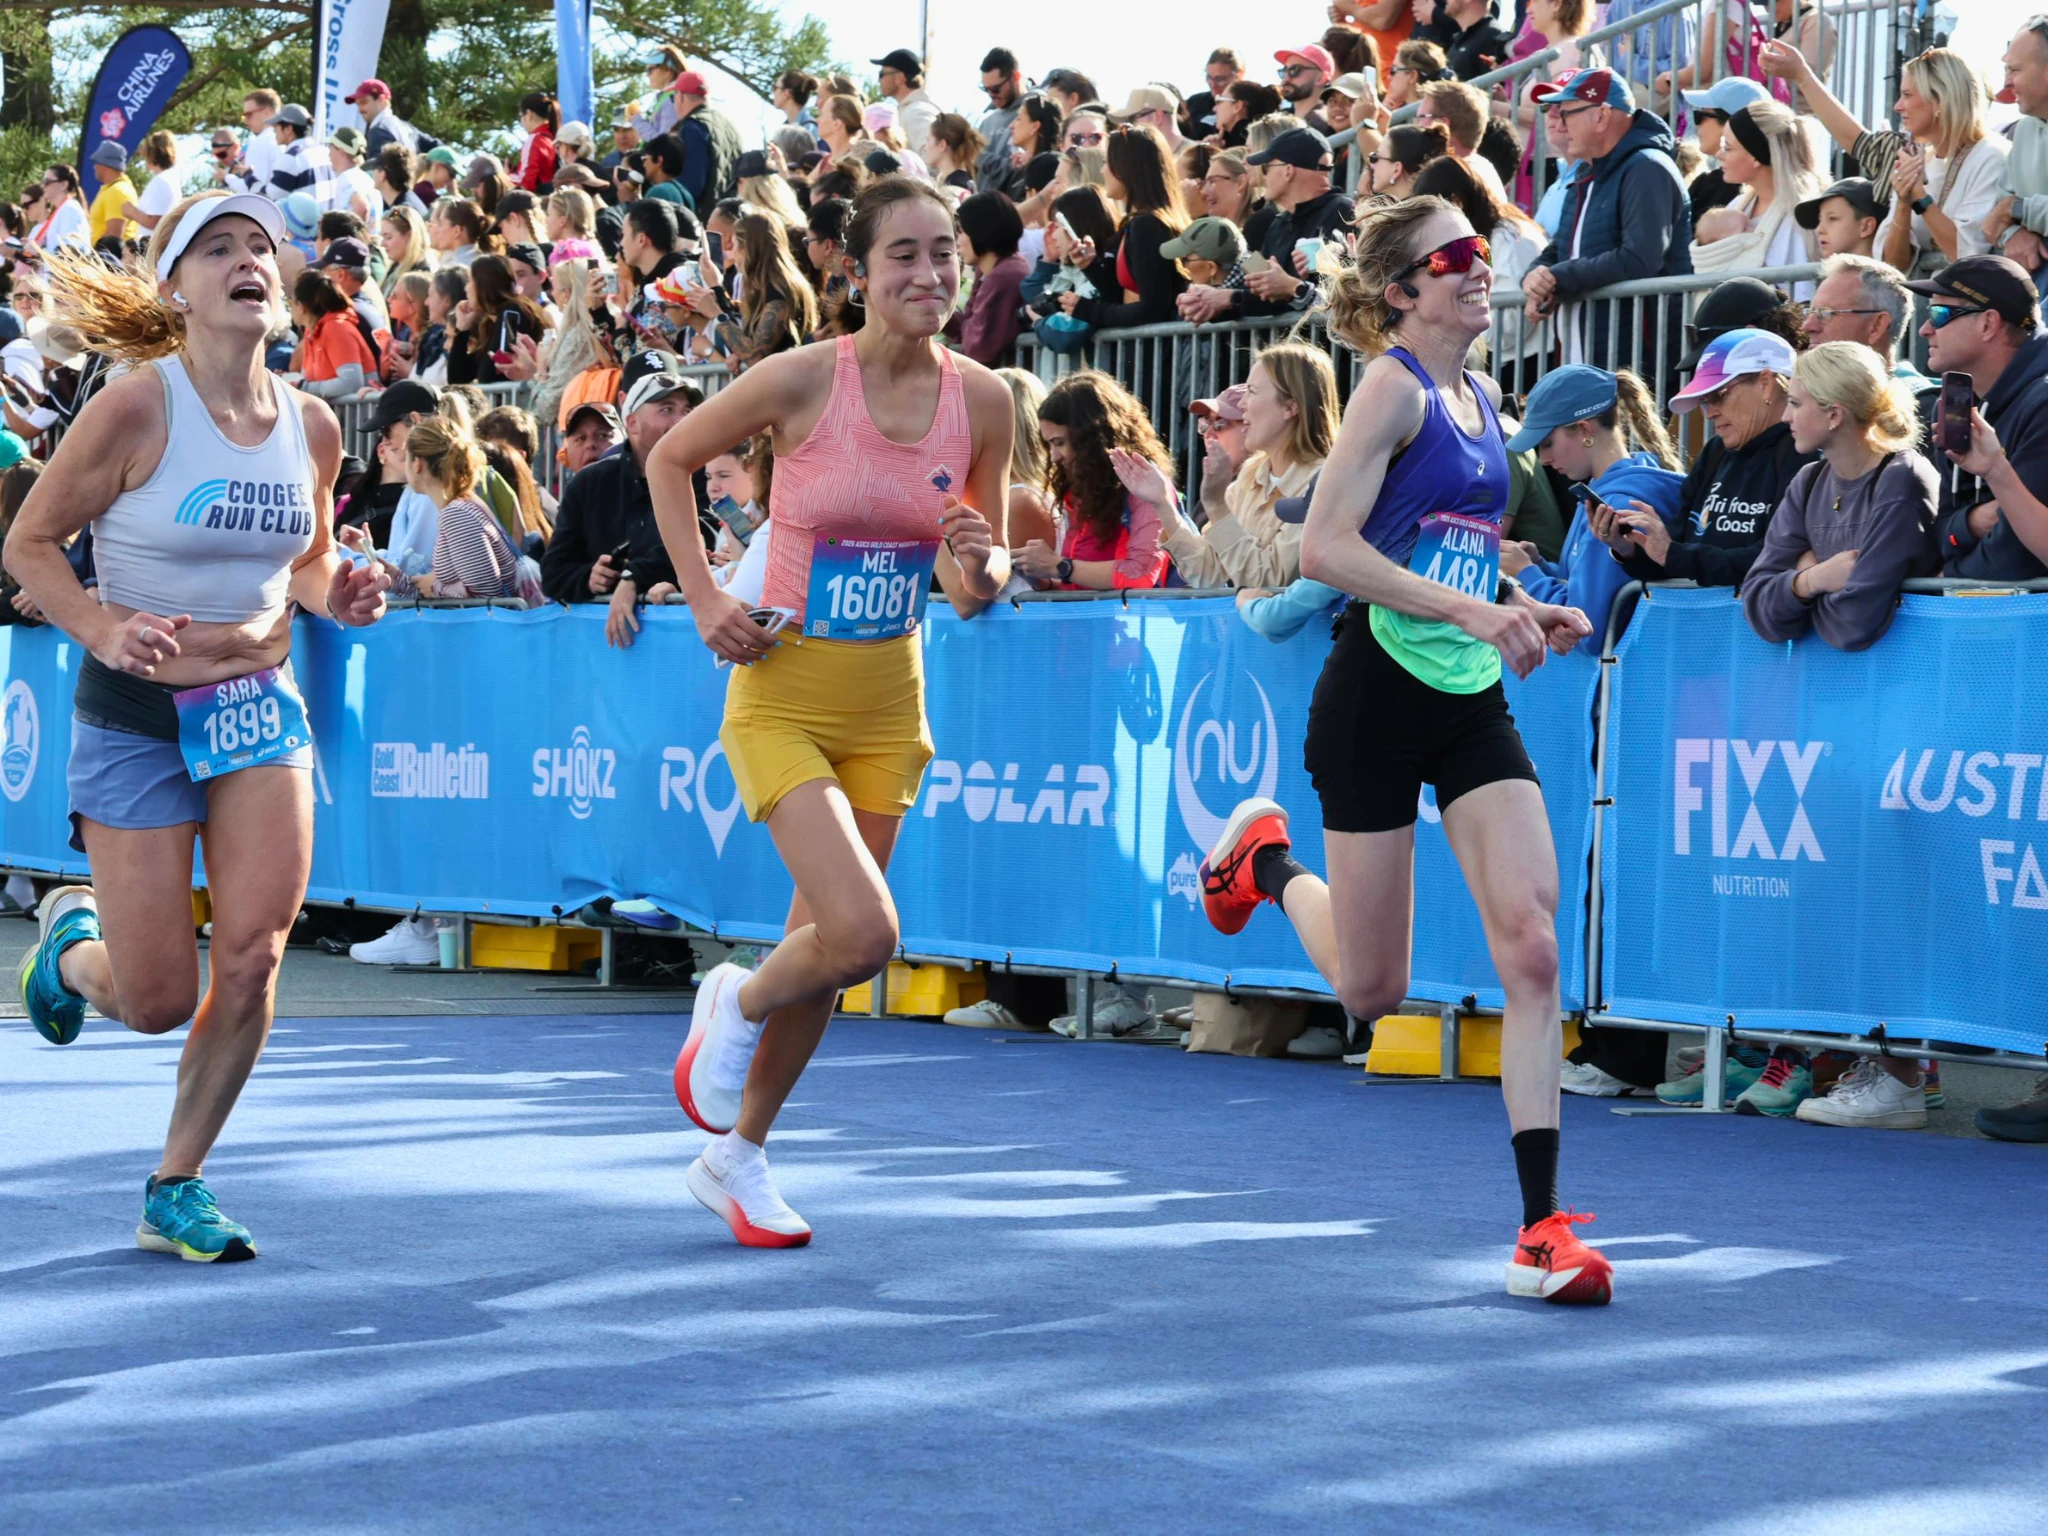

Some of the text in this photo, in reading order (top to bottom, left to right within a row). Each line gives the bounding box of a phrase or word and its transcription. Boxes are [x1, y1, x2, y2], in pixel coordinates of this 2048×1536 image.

[327, 0, 352, 70] ross
[117, 52, 159, 101] CHINA
[124, 48, 176, 121] AIRLINES
[228, 480, 308, 507] COOGEE
[1708, 494, 1728, 514] Tri
[205, 504, 312, 536] RUN CLUB
[1715, 515, 1756, 534] Coast
[862, 551, 898, 573] MEL
[883, 541, 899, 549] COAST
[1440, 526, 1484, 558] ALANA
[827, 572, 920, 620] 16081
[1424, 551, 1490, 602] 4484
[216, 676, 262, 707] SARA
[204, 696, 281, 755] 1899
[402, 742, 489, 799] Bulletin
[532, 747, 616, 799] SHOKZ
[922, 759, 1110, 827] POLAR
[1674, 738, 1827, 862] FIXX
[1170, 871, 1198, 891] pure
[1712, 873, 1790, 898] NUTRITION
